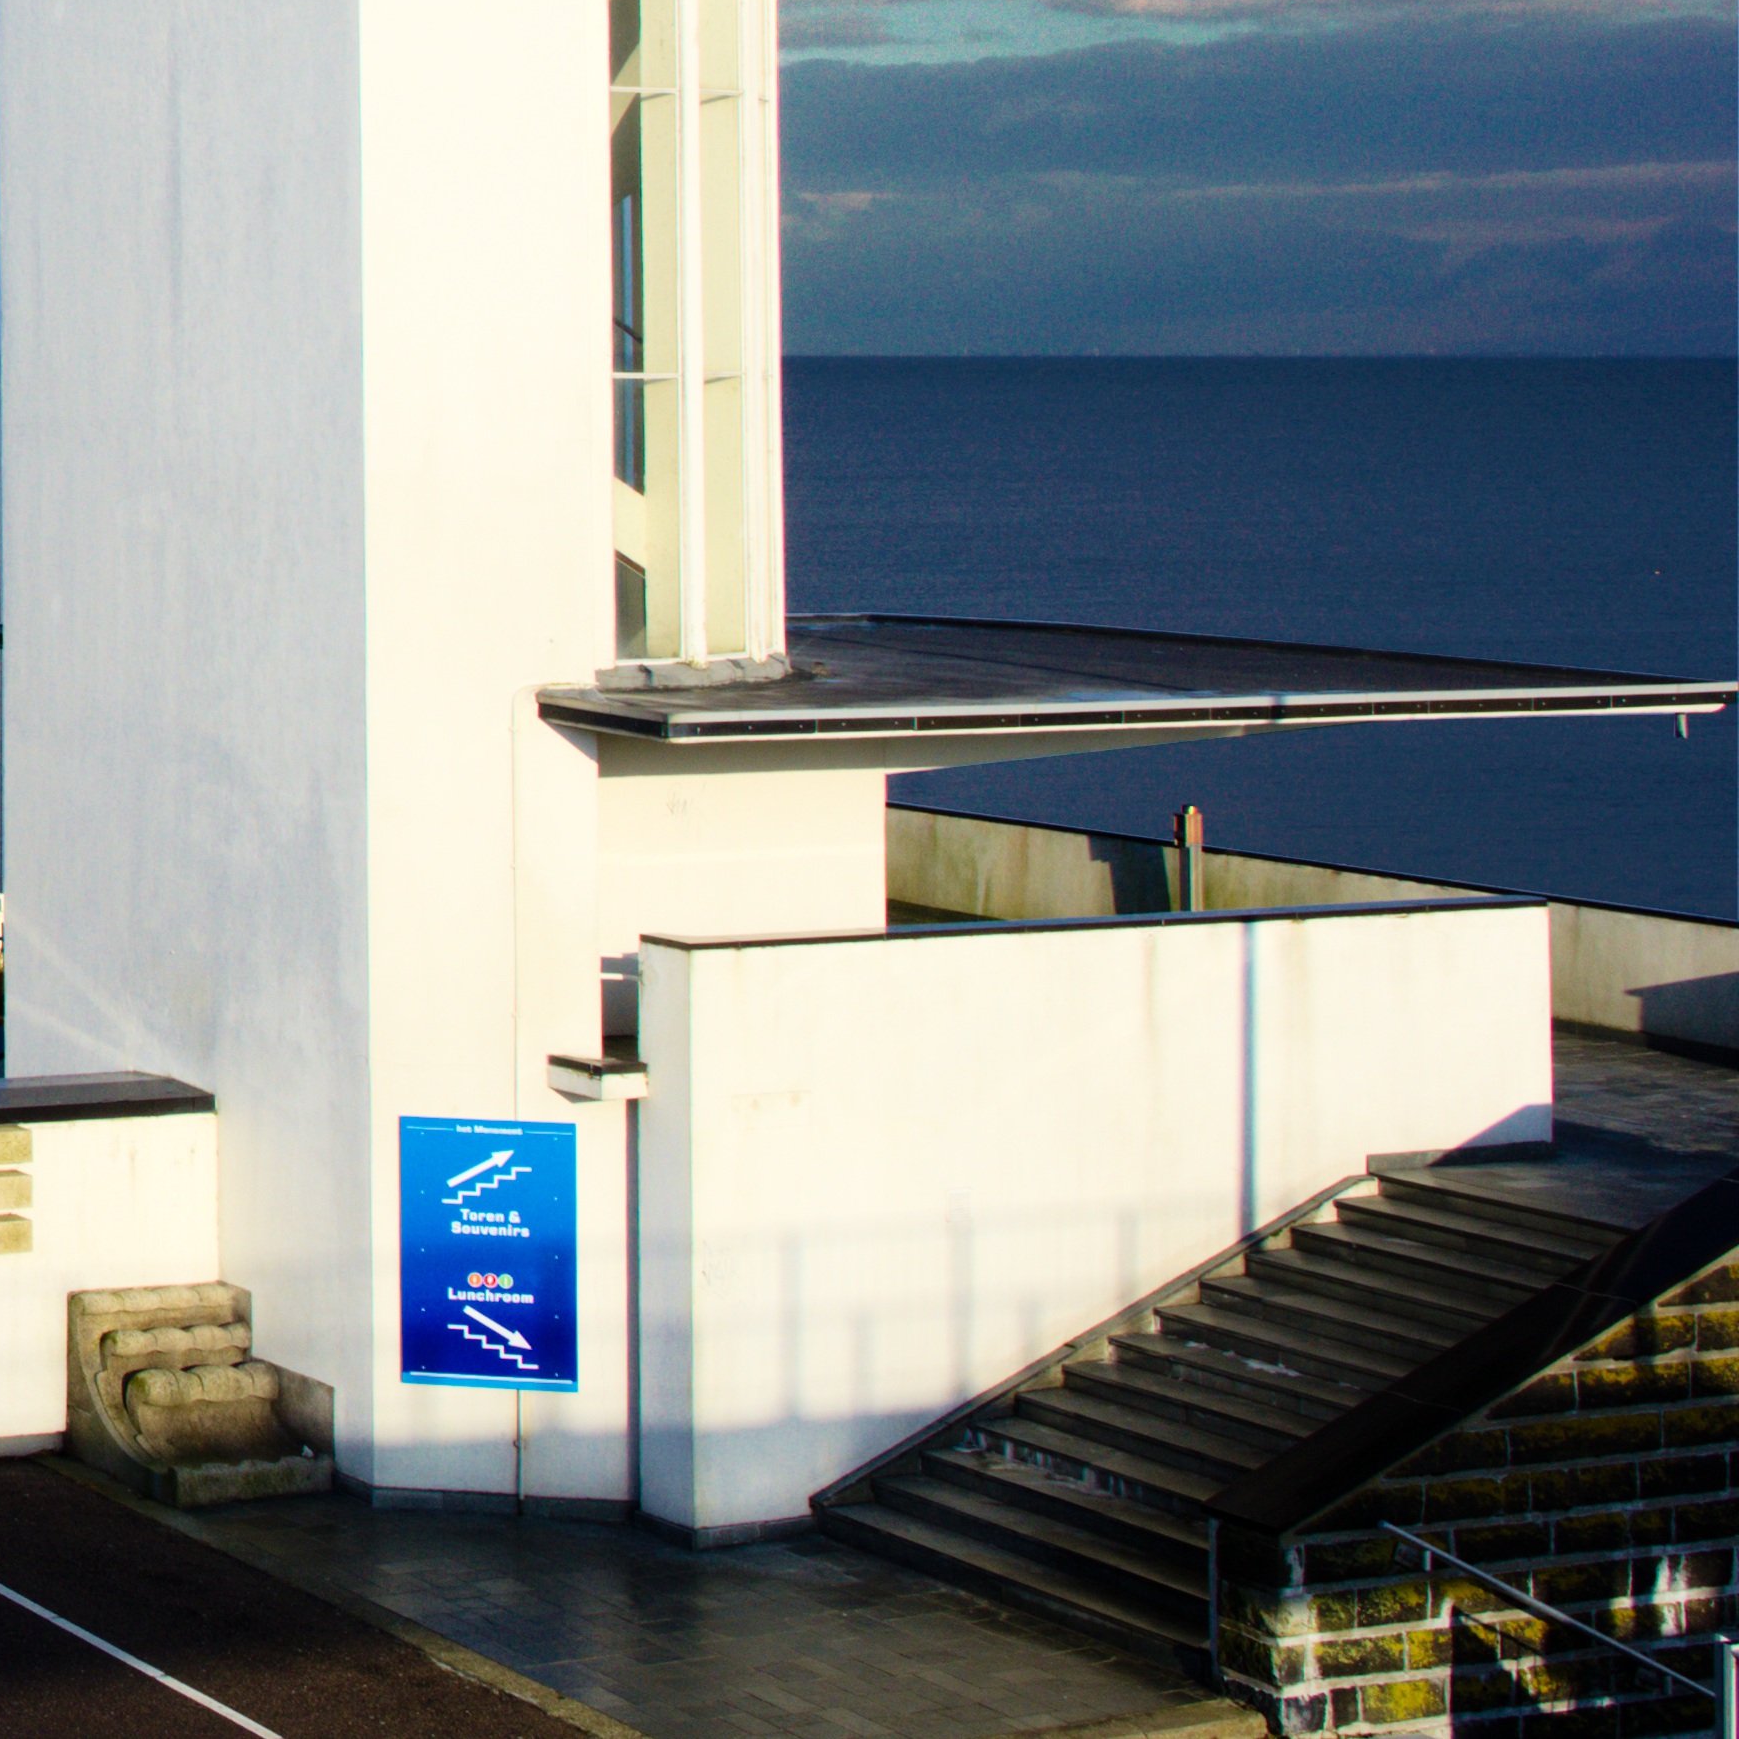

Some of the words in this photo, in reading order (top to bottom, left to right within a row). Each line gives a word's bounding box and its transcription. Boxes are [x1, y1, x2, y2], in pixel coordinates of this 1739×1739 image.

[459, 1208, 505, 1223] Toren
[508, 1210, 521, 1224] &
[451, 1220, 530, 1238] Souvenirs
[447, 1286, 535, 1304] Lunchroom
